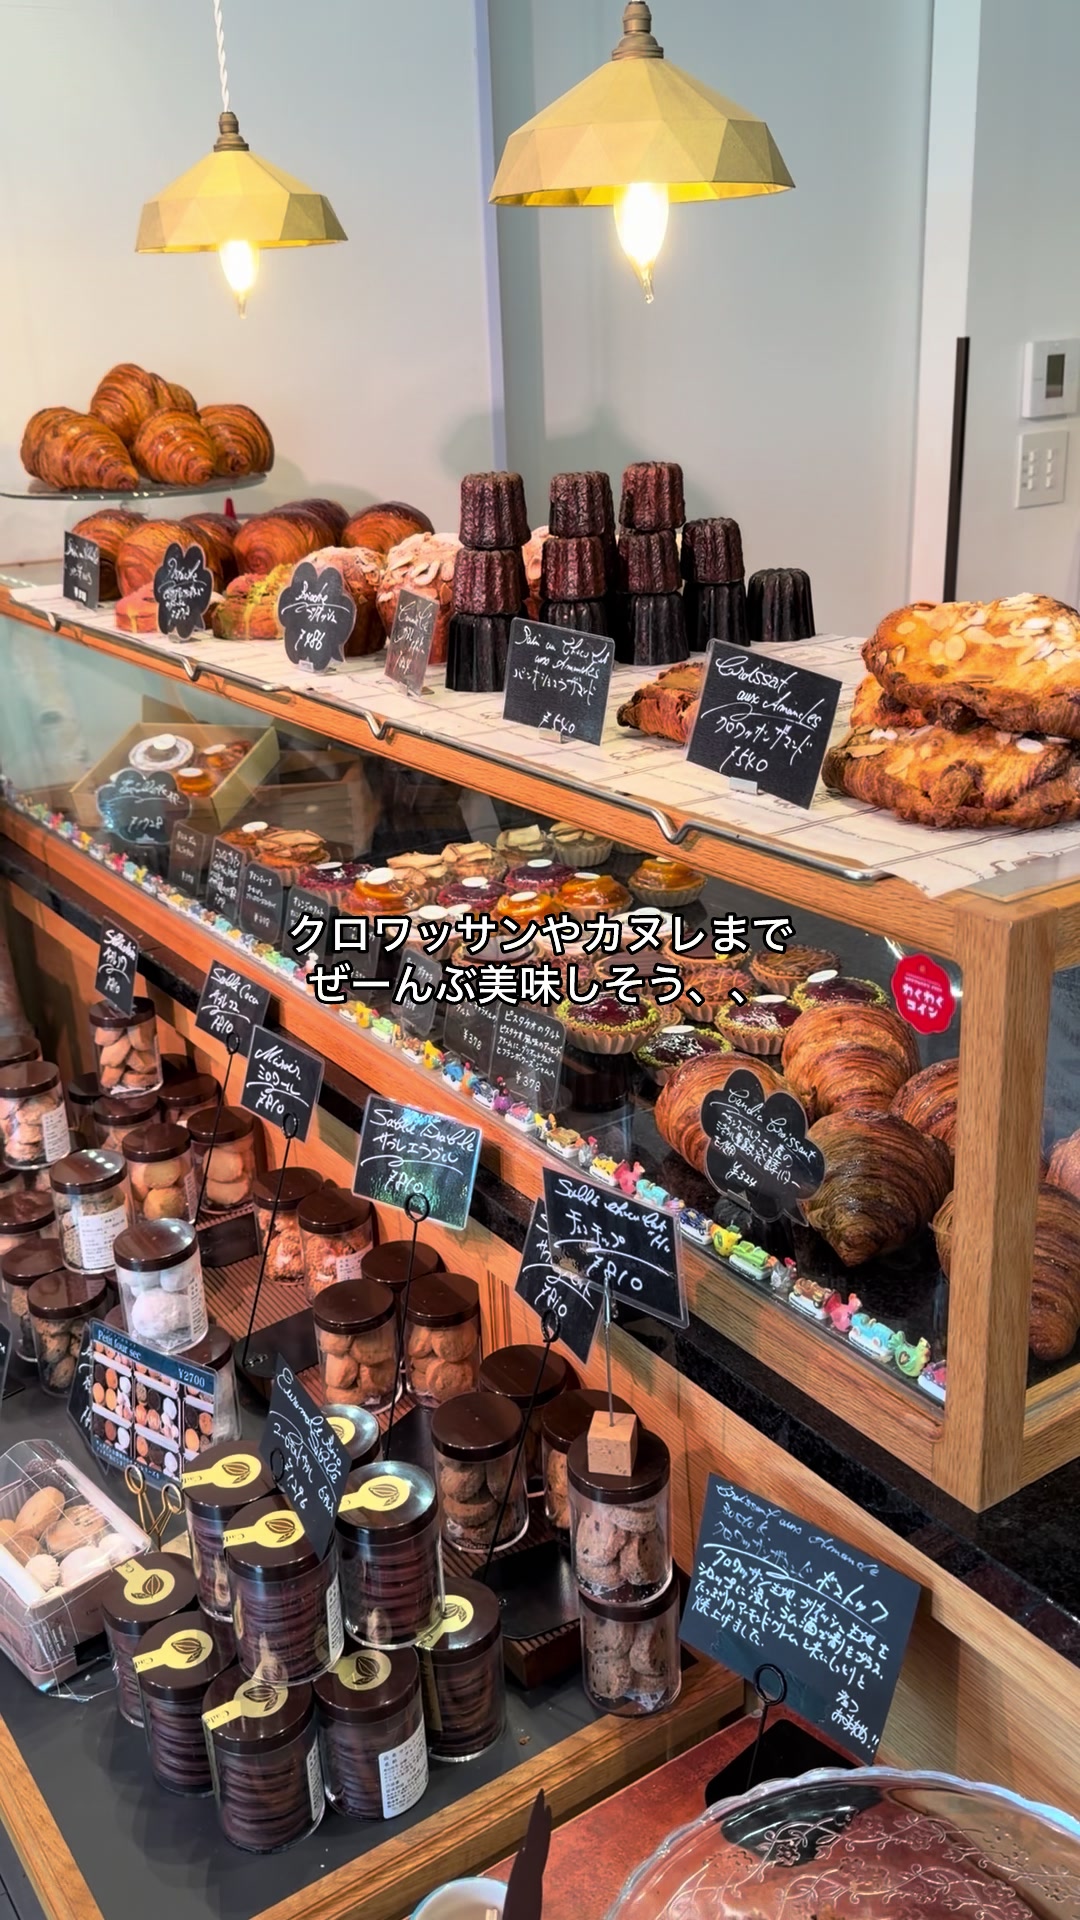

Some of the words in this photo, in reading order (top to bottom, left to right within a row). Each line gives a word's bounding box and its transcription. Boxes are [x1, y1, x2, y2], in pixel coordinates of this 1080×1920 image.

[736, 690, 761, 705] aux
[538, 710, 576, 733] ¥540
[718, 746, 769, 773] ¥540
[902, 983, 944, 1009] わくわく
[906, 999, 938, 1019] コイン
[504, 1010, 560, 1040] ピスタチオのタルト
[463, 1028, 483, 1051] ¥378
[515, 1071, 541, 1093] ¥378
[385, 1170, 424, 1193] ¥810
[725, 1161, 758, 1188] ¥324
[587, 1255, 643, 1291] ¥810
[535, 1282, 567, 1317] ¥810
[97, 1329, 114, 1345] Petit
[113, 1336, 128, 1354] four
[128, 1345, 141, 1361] sec
[177, 1367, 206, 1389] ¥2700
[815, 1570, 889, 1623] ボストック
